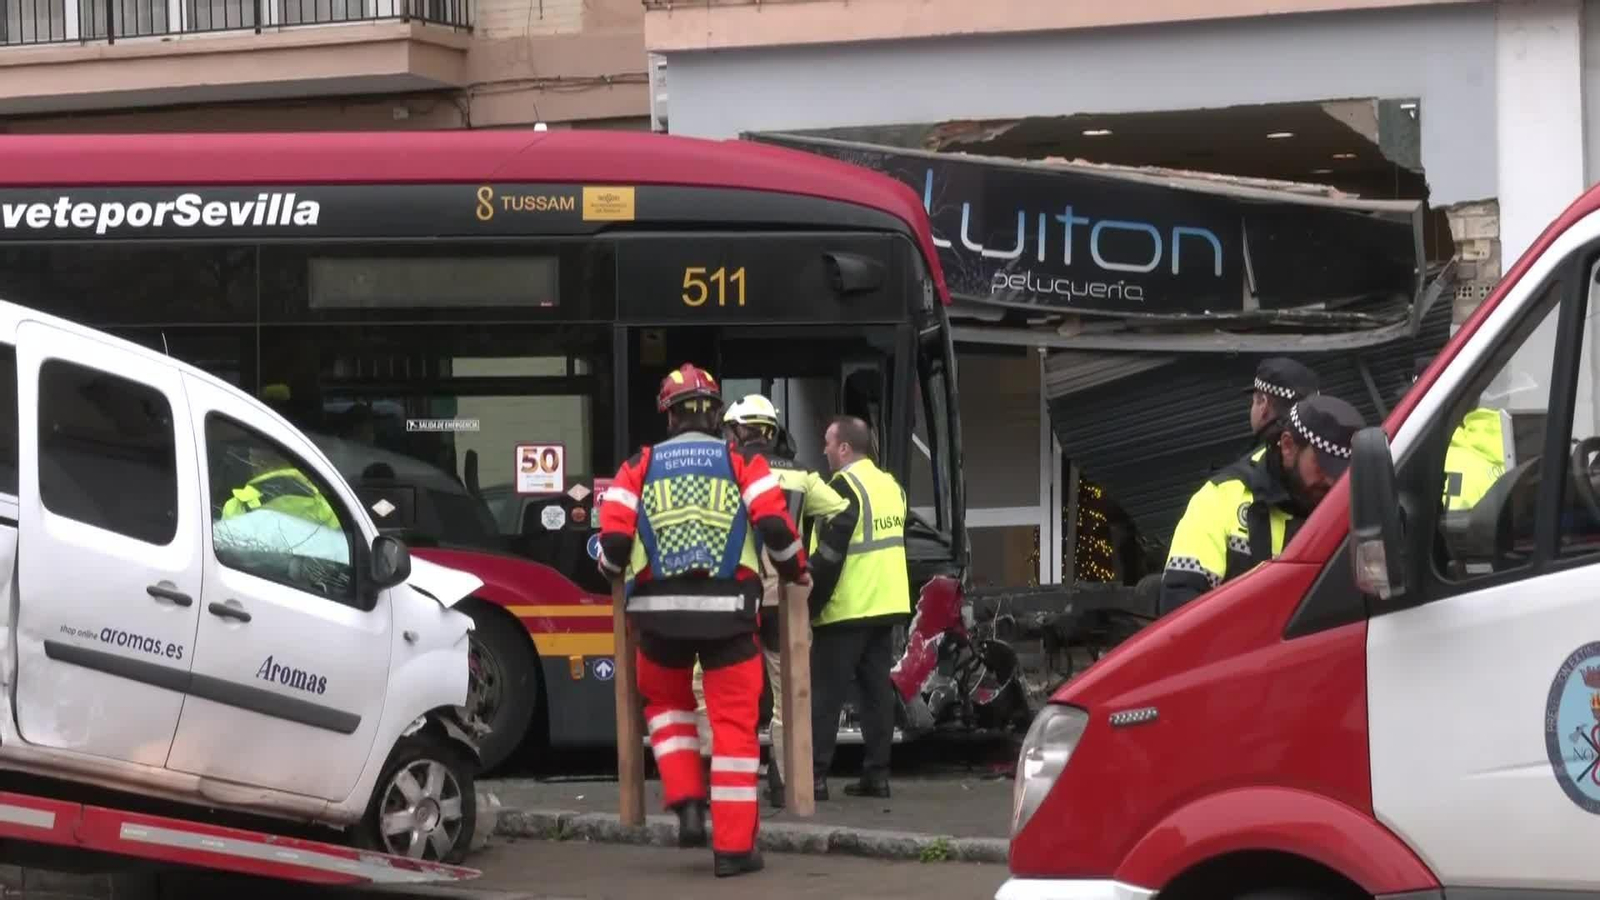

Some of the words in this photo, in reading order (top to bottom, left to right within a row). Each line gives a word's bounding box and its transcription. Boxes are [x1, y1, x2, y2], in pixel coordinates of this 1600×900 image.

[500, 195, 575, 211] TUSSAM
[681, 266, 747, 307] 511
[520, 447, 559, 473] 50
[655, 447, 722, 461] BOMBEROS
[664, 457, 713, 470] SEVILLA
[60, 624, 76, 637] shop
[77, 628, 98, 641] online
[100, 624, 184, 660] aromas.es
[255, 654, 328, 696] Aromas
